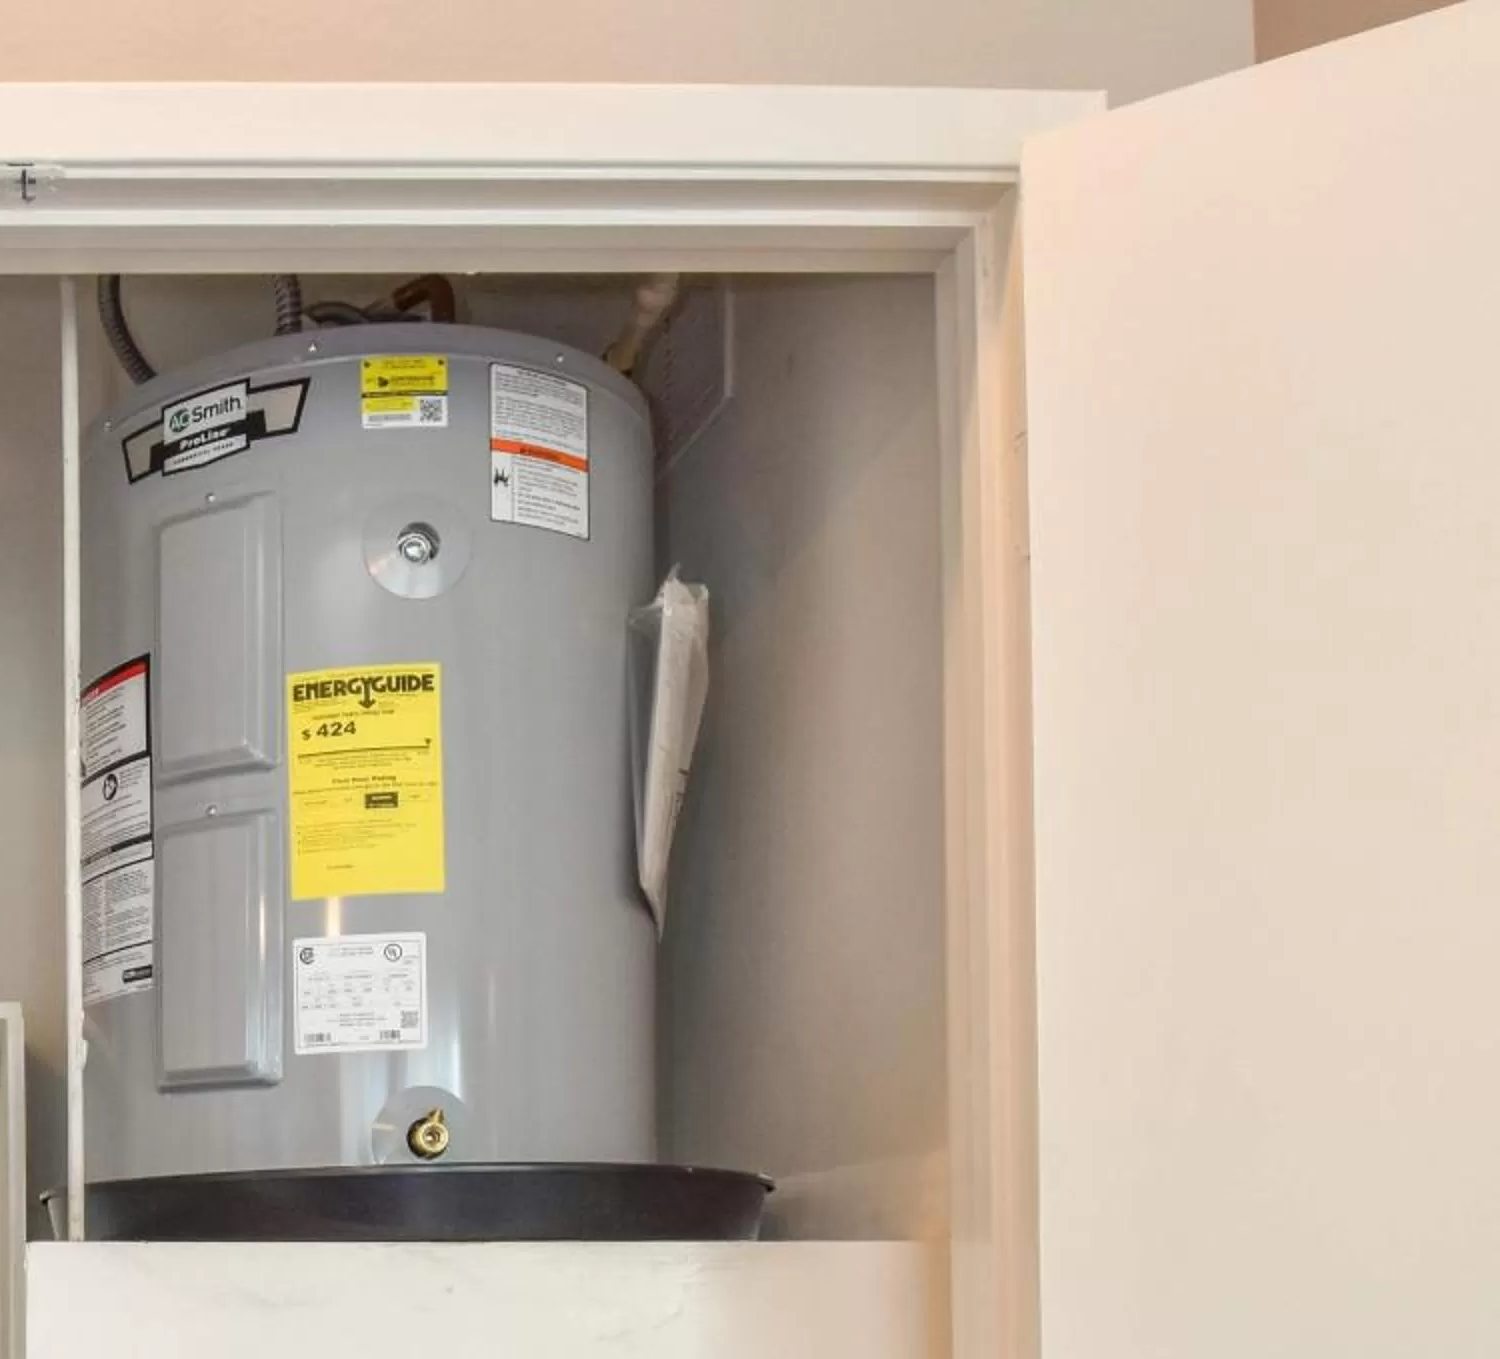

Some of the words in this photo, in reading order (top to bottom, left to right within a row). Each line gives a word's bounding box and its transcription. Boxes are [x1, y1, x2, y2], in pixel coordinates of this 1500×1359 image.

[191, 396, 242, 423] Smith
[293, 674, 435, 702] ENERGYGUIDE
[316, 721, 357, 737] 424
